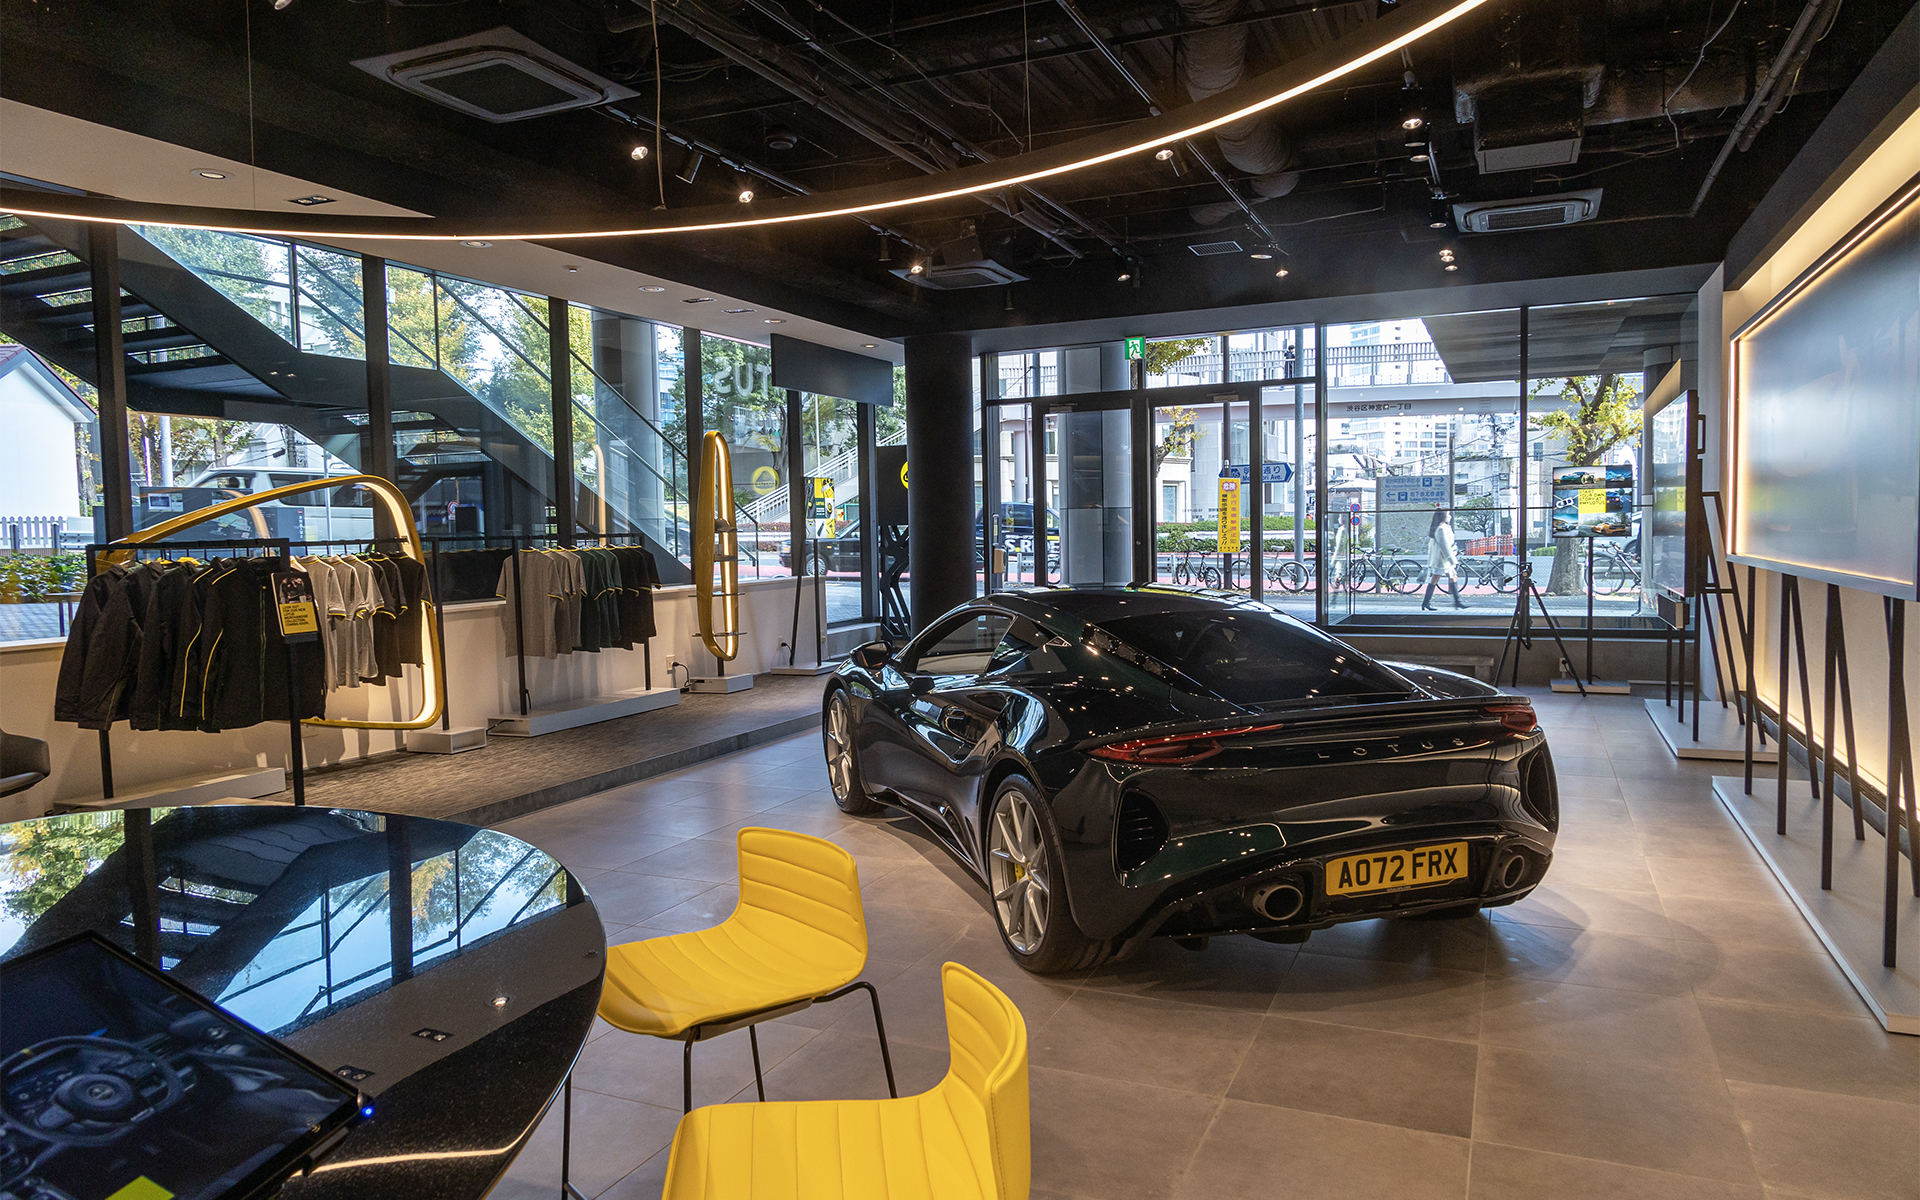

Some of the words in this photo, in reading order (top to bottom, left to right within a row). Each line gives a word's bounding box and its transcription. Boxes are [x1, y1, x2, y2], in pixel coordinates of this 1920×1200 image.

[1346, 402, 1412, 412] 渋谷区神宮前一丁目
[1243, 465, 1281, 475] 明通り
[1222, 482, 1236, 490] 危険
[1317, 738, 1464, 758] LOTUS
[1338, 855, 1404, 889] AO72
[1412, 847, 1458, 879] FRX
